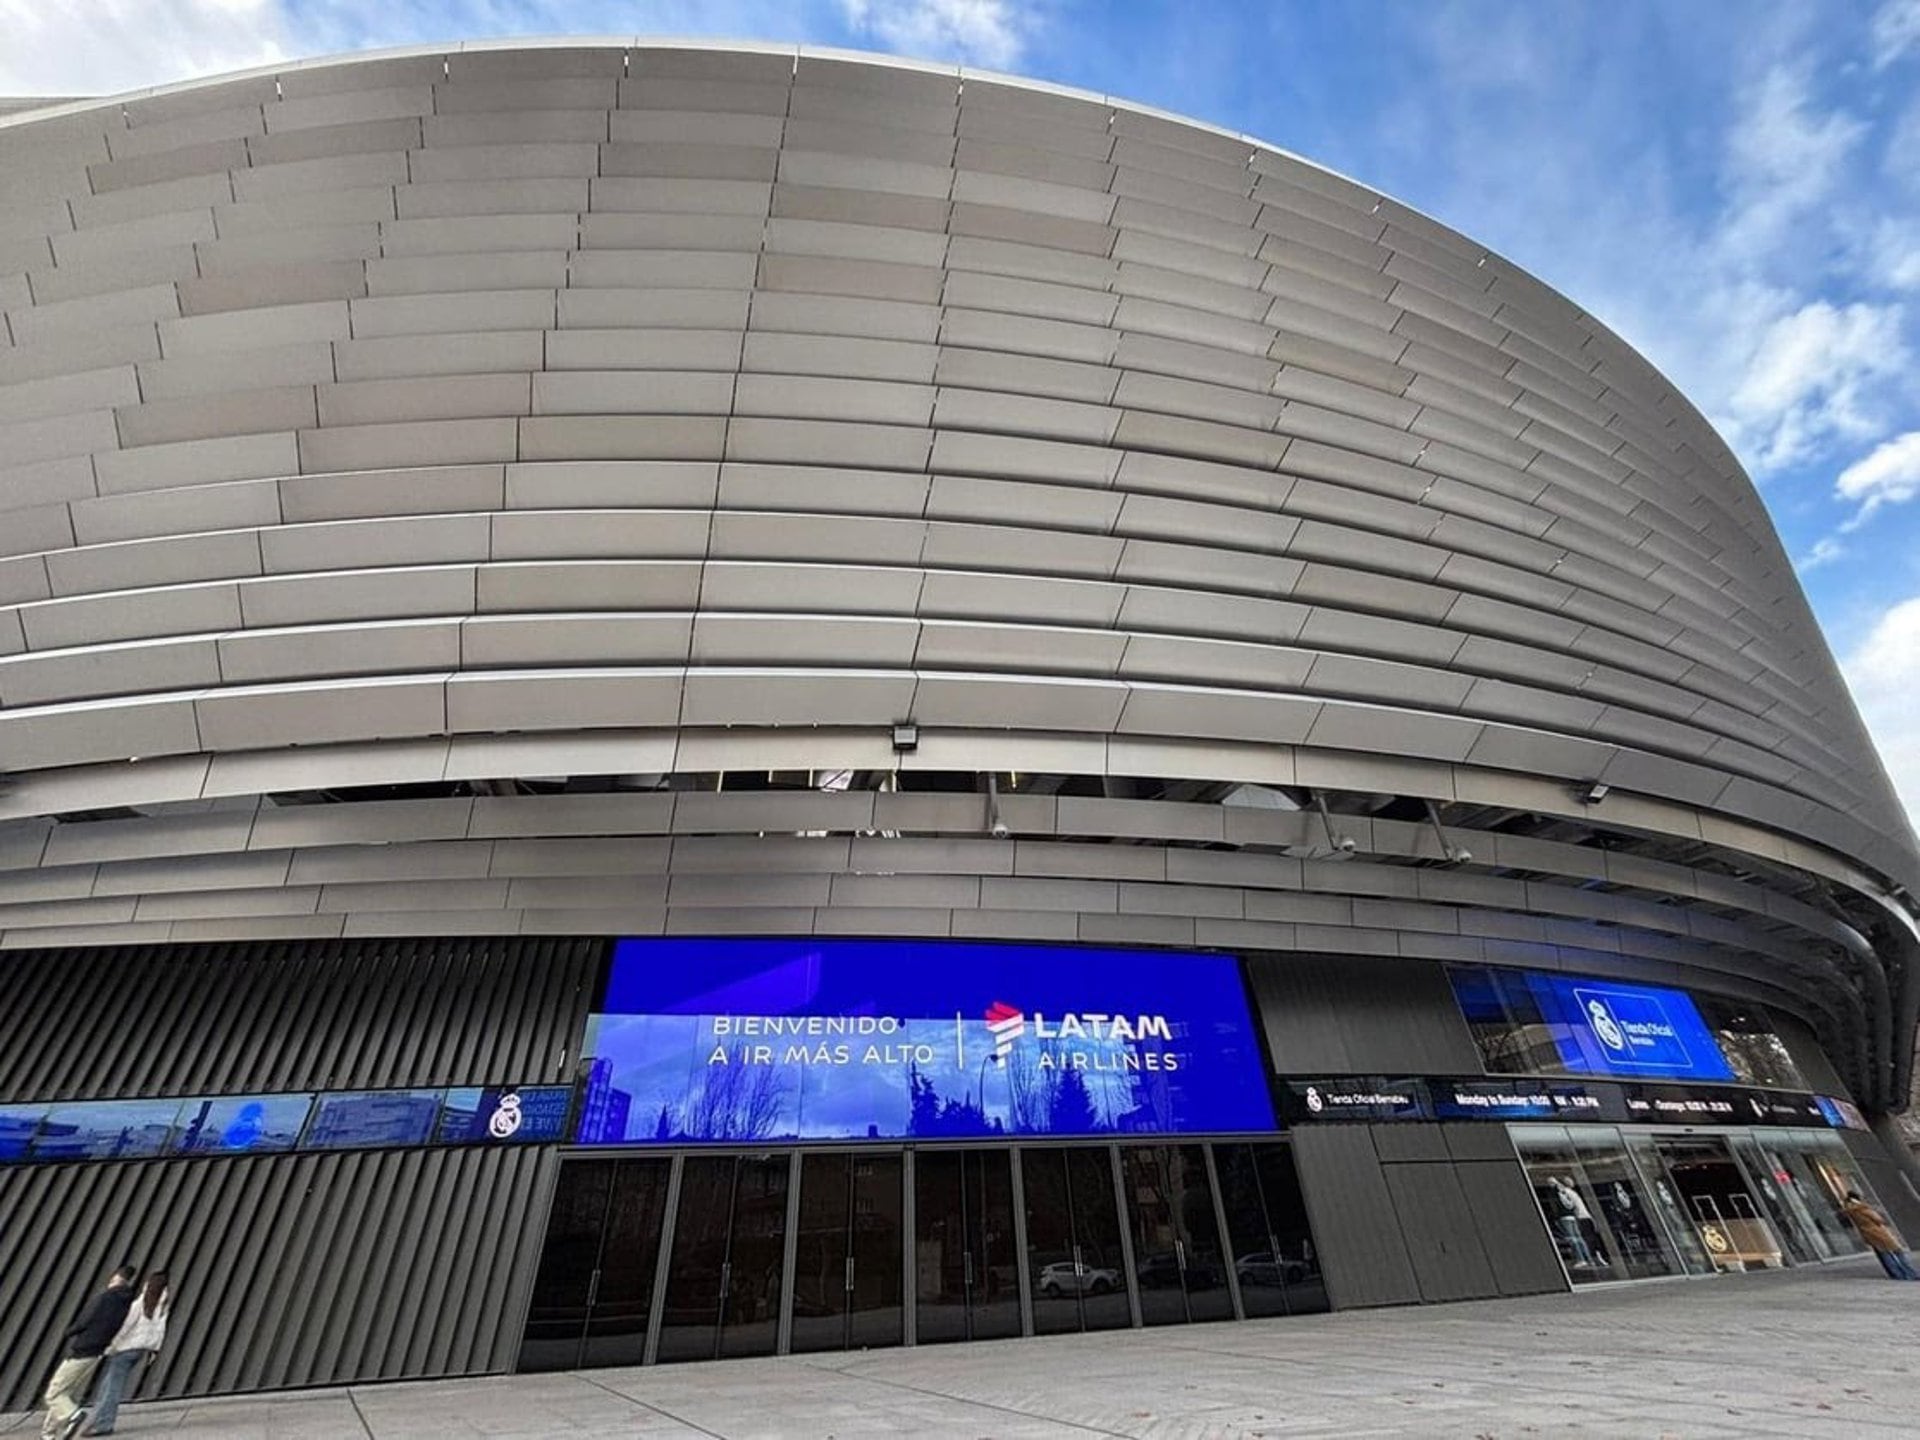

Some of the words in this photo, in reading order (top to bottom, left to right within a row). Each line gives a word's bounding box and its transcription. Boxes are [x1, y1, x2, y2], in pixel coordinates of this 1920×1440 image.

[713, 1016, 898, 1035] BIENVENIDO
[1034, 1013, 1173, 1040] LATAM
[708, 1046, 729, 1065] A
[743, 1046, 773, 1065] IR
[784, 1041, 850, 1064] MÁS
[862, 1045, 934, 1064] ALTO
[1038, 1052, 1178, 1070] AIRLINES
